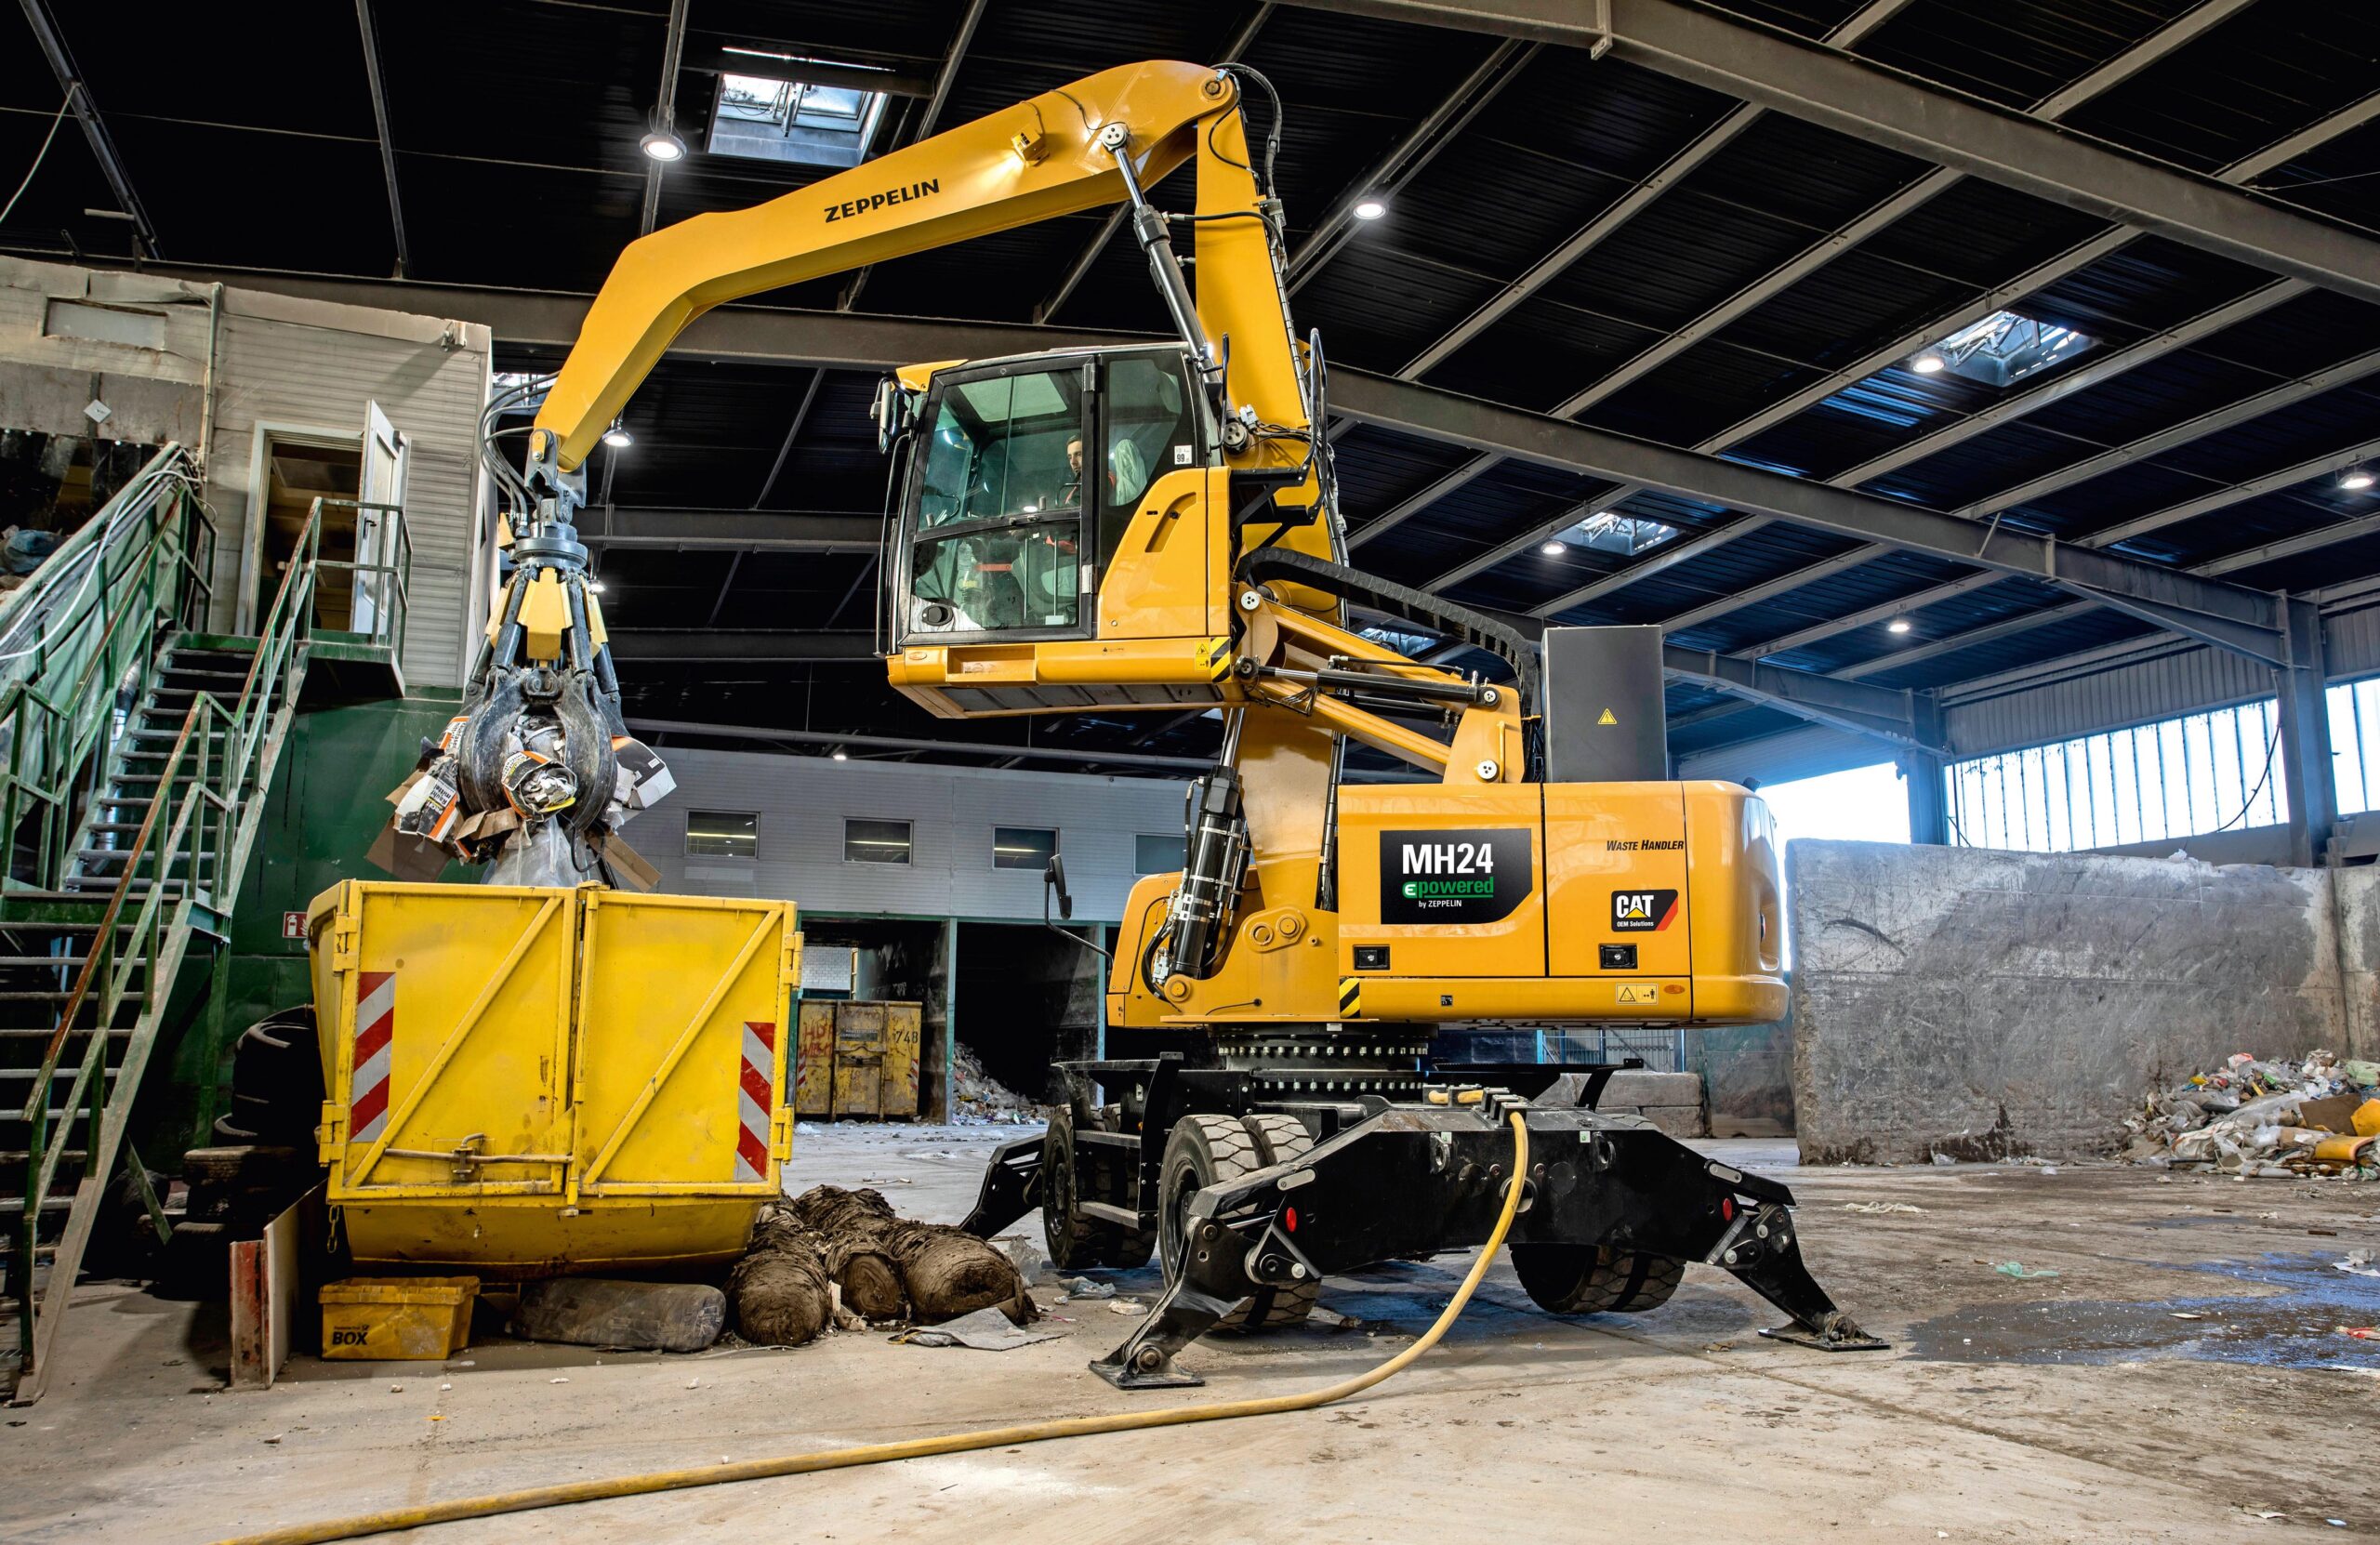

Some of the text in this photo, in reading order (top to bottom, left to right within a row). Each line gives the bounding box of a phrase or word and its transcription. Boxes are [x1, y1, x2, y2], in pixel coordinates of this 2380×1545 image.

[824, 178, 940, 223] ZEPPELIN
[1402, 843, 1494, 874] MH24
[1419, 899, 1462, 909] by ZEPPELIN
[1616, 894, 1654, 918] CAT
[895, 1030, 919, 1044] 748
[332, 1331, 368, 1345] BOX
